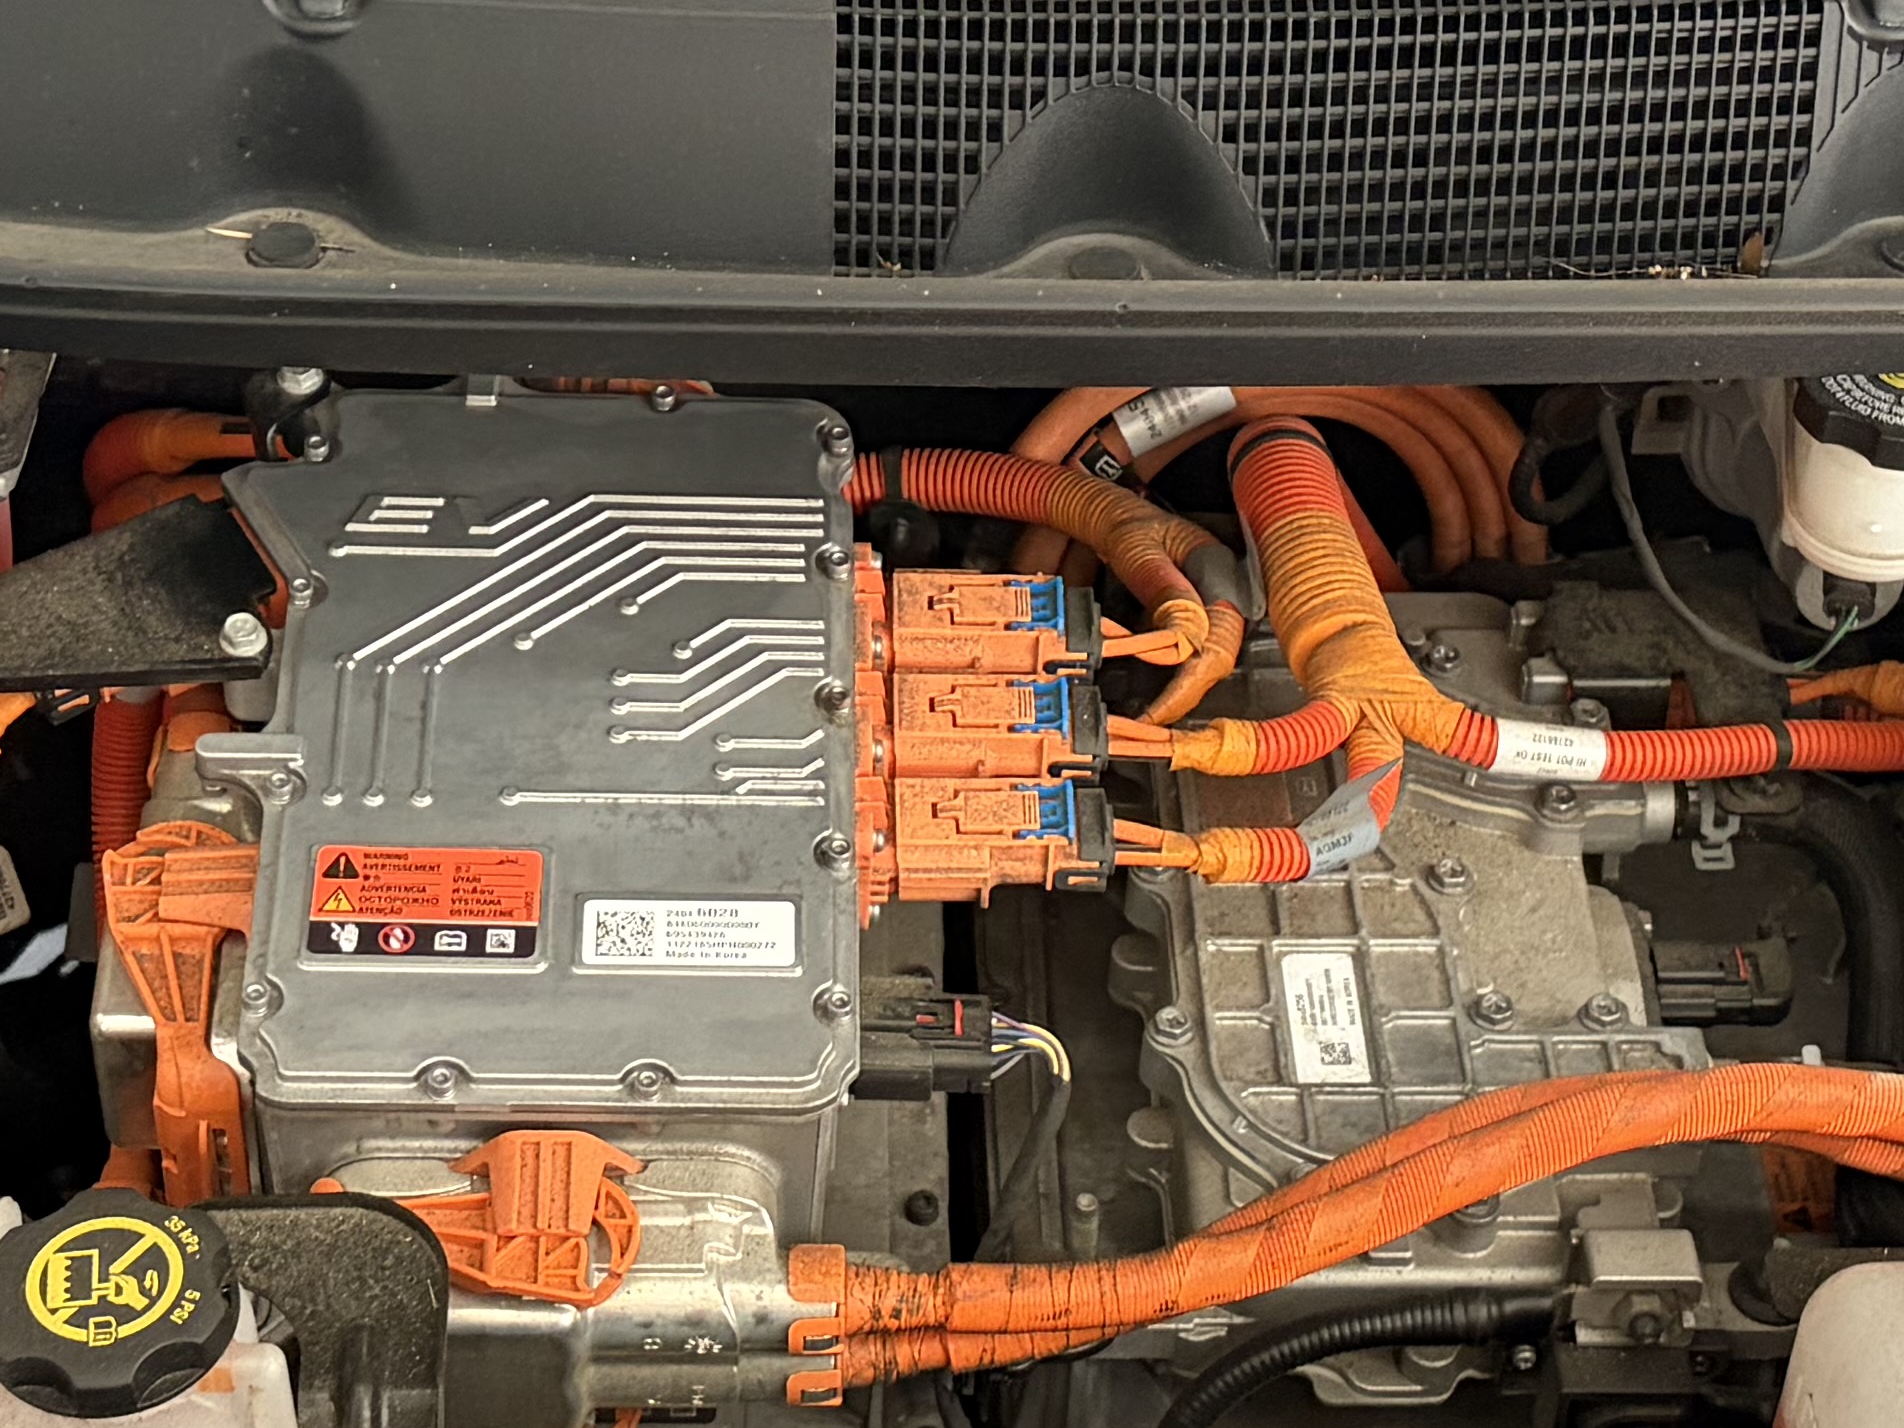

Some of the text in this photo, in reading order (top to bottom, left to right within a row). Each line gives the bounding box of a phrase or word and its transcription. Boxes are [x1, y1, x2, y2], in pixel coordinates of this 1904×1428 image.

[1840, 395, 1872, 416] FLUID
[344, 495, 549, 535] EV
[1530, 752, 1553, 764] TEST
[1557, 754, 1573, 766] POT
[164, 1215, 186, 1232] 35
[169, 1289, 201, 1325] 5 PSI
